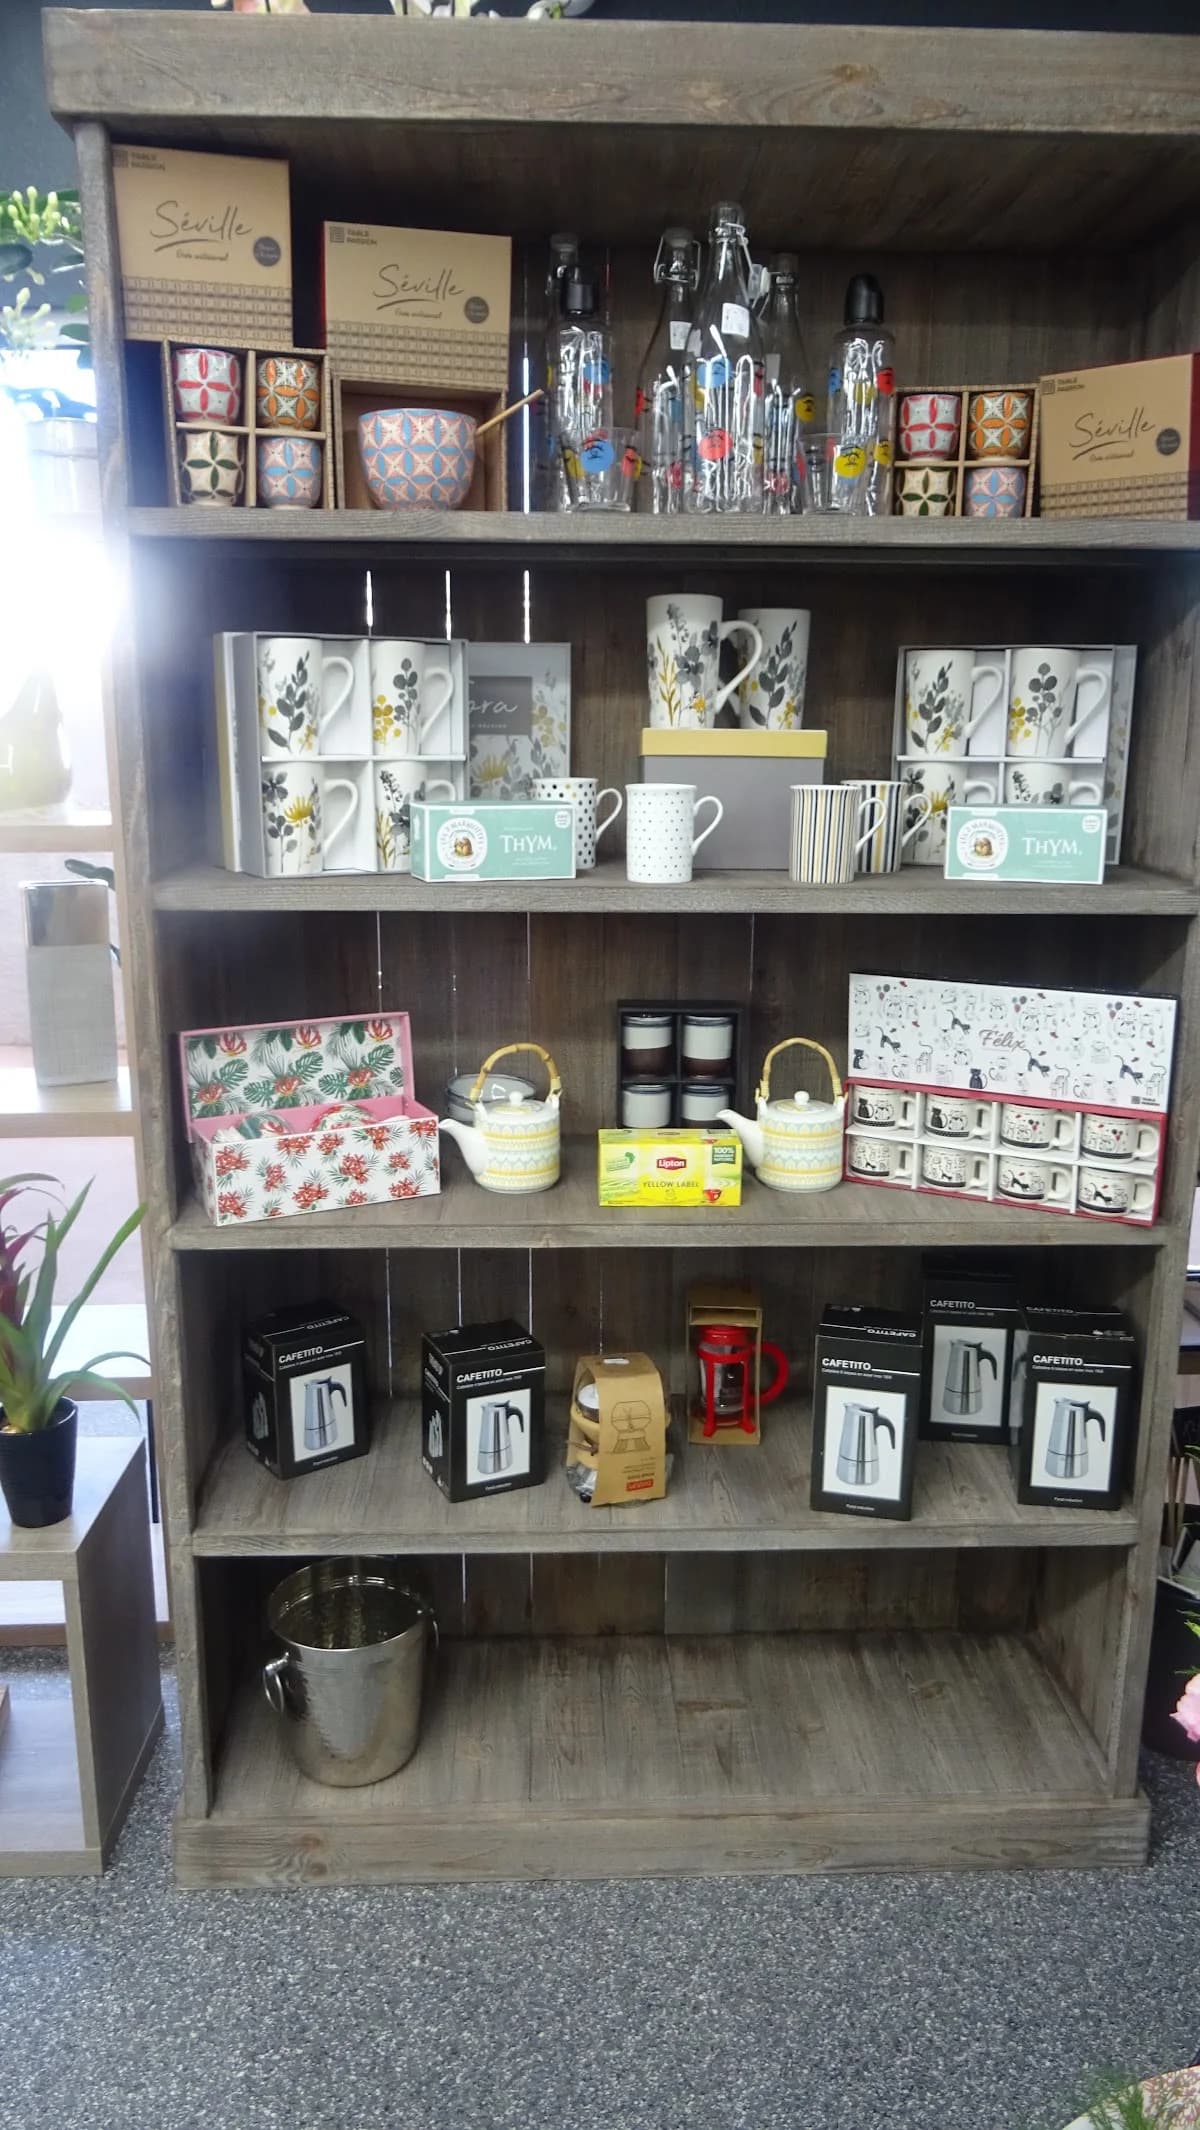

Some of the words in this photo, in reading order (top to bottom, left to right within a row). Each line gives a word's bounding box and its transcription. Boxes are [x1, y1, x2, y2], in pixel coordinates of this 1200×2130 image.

[150, 200, 252, 240] Séville
[372, 263, 464, 301] Séville
[1068, 405, 1156, 448] Séville
[978, 1029, 1026, 1052] Félix
[713, 1146, 735, 1154] 100%
[658, 1159, 685, 1168] Lipton
[643, 1180, 674, 1188] YELLOW
[676, 1180, 699, 1188] LABEL
[929, 1299, 976, 1309] CAFETITO
[867, 1328, 917, 1338] CAFETITO
[279, 1345, 323, 1364] CAFETITO
[1032, 1354, 1084, 1366] CAFETITO
[821, 1357, 872, 1371] CAFETITO
[456, 1368, 503, 1383] CAFETITO
